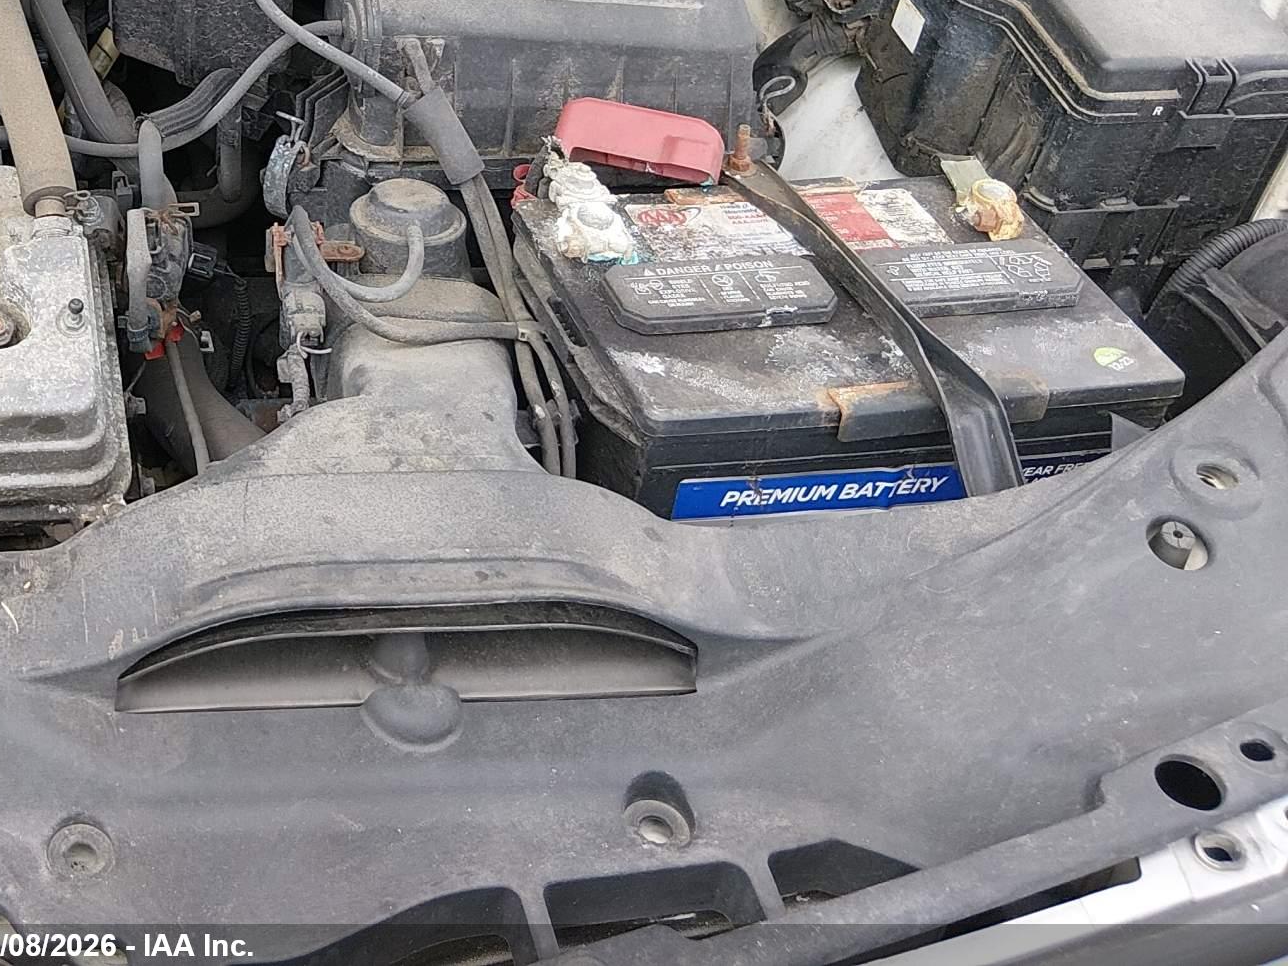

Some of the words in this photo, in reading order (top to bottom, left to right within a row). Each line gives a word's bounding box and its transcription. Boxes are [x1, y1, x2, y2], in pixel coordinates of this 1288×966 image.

[1152, 106, 1164, 116] R
[655, 264, 712, 276] DANGER
[724, 260, 775, 272] POISON
[720, 484, 838, 507] PREMIUM
[839, 476, 949, 500] BATTERY
